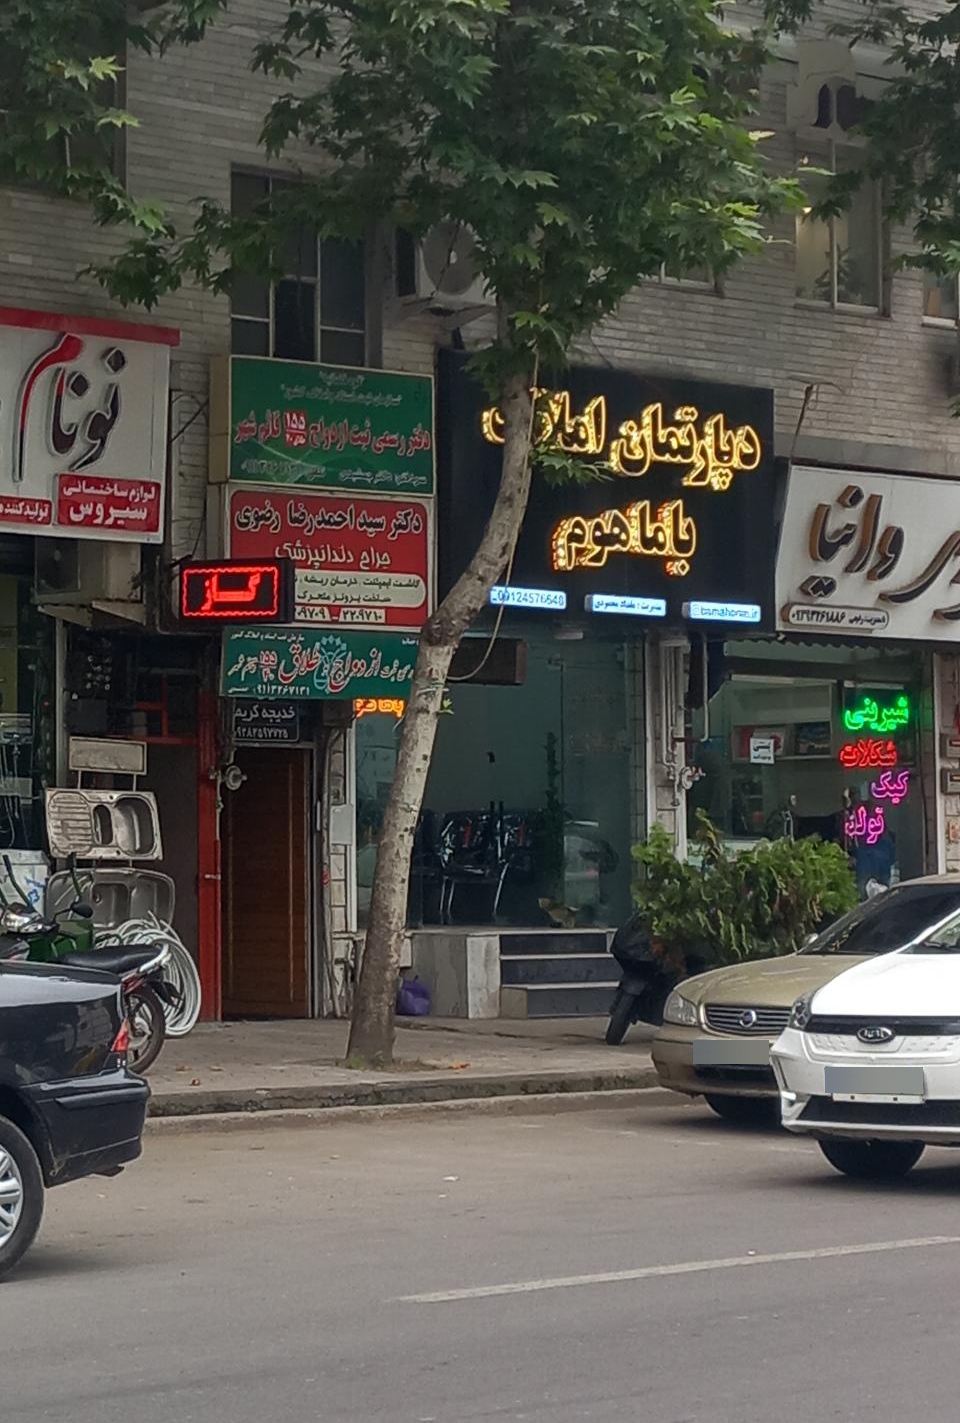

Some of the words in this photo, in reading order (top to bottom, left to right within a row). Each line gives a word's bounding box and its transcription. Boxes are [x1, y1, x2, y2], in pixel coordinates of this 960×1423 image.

[309, 416, 349, 451] ازدواج
[349, 418, 372, 451] ثبت
[371, 430, 407, 456] رسمی
[406, 423, 431, 457] دفتر
[610, 402, 761, 491] دپارتمان
[62, 479, 129, 497] ساختمانی
[127, 481, 156, 503] لوازم
[68, 501, 149, 525] سیروس
[234, 499, 282, 534] رضوی
[356, 510, 387, 538] سید
[387, 508, 423, 540] دکتر
[360, 547, 391, 570] جراح
[200, 572, 262, 611] گاز
[295, 606, 327, 620] ۰۹۷۰۹
[260, 705, 296, 723] خدیجه
[844, 695, 910, 732] شیرینی
[839, 738, 898, 767] شکلات
[870, 770, 910, 804] کیک
